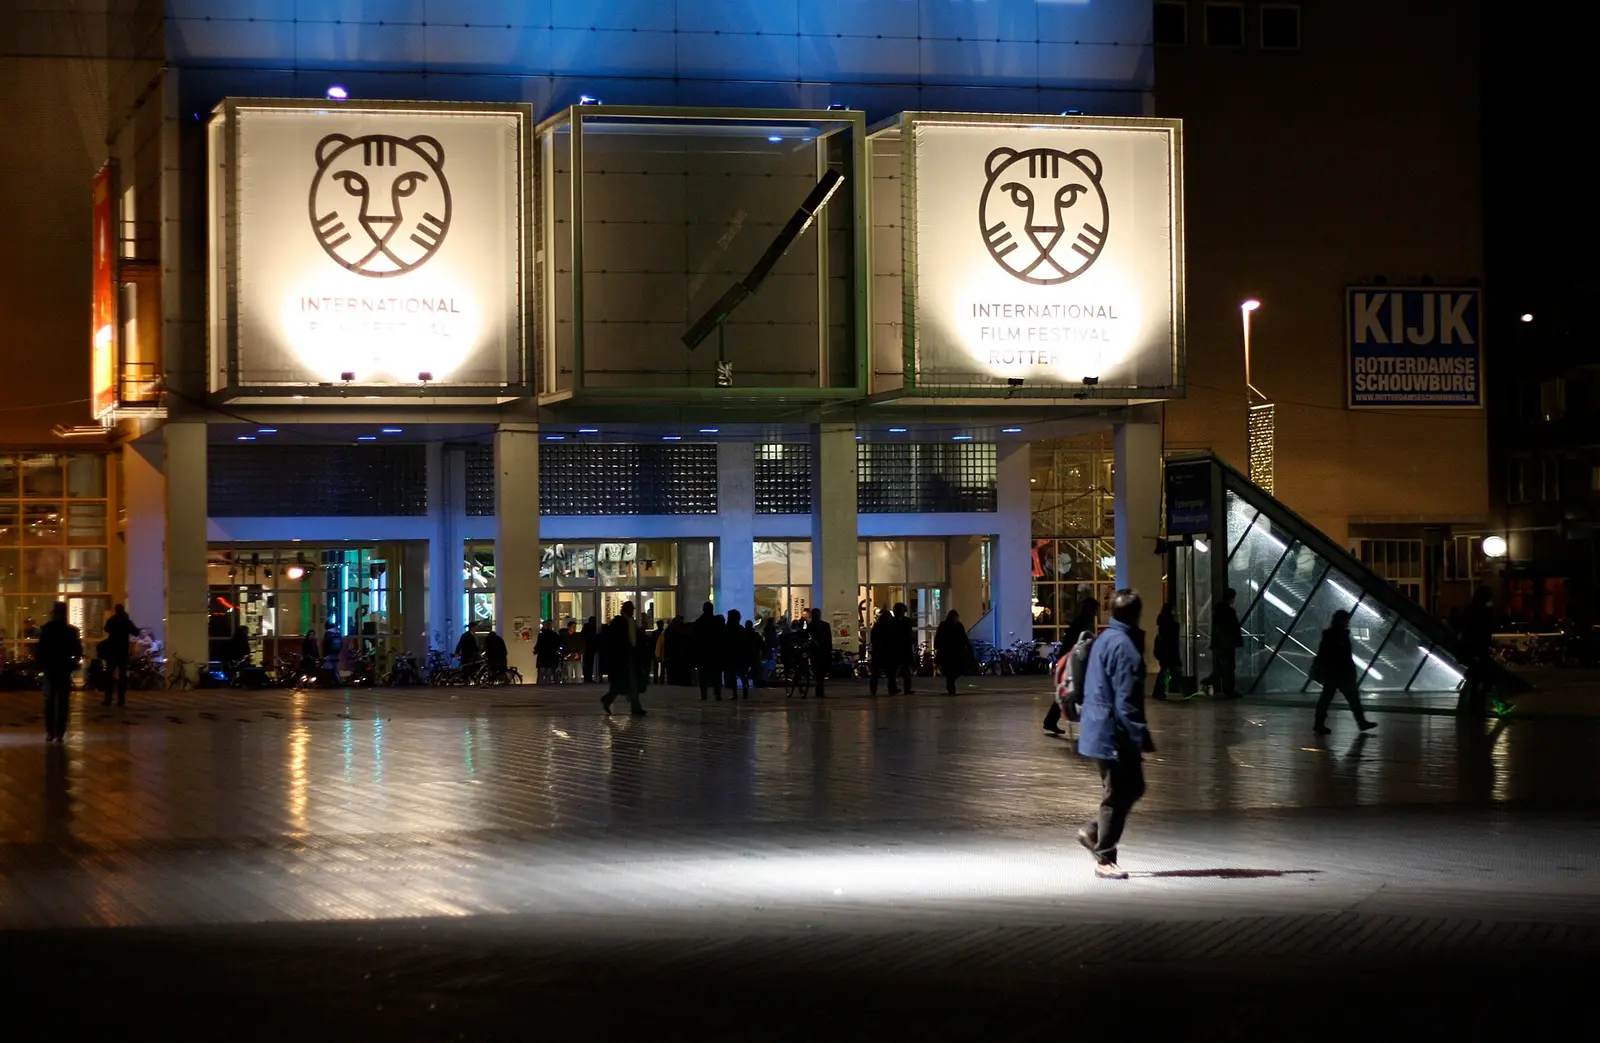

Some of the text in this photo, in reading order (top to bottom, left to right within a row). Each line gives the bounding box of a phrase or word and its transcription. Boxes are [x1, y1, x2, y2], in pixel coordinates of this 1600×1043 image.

[301, 297, 461, 313] INTERNATIONAL
[973, 303, 1118, 319] INTERNATIONAL
[1354, 293, 1475, 344] KIJK
[981, 327, 1110, 342] FILM FESTIVAL
[1354, 357, 1475, 374] ROTTERDAMSE
[1355, 374, 1475, 391] SCHOUWBURG
